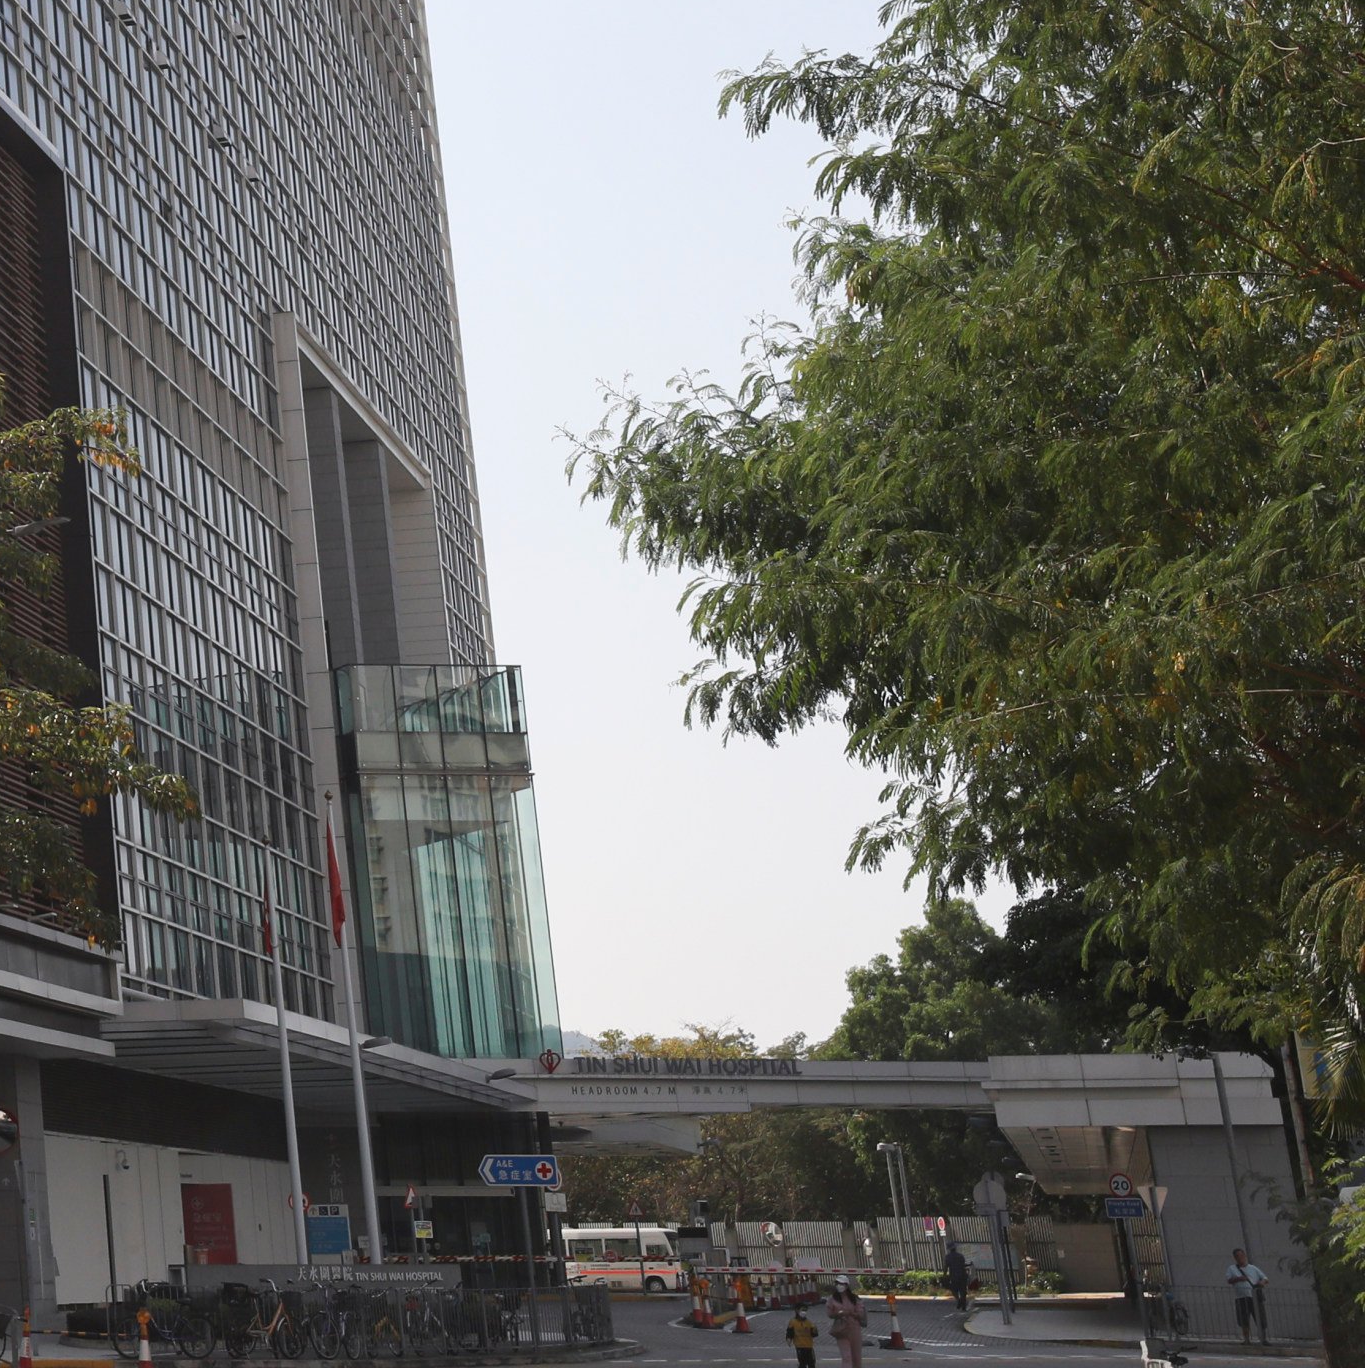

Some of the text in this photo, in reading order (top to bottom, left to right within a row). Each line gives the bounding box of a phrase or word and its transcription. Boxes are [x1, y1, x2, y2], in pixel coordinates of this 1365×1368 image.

[573, 1056, 804, 1076] TIN SHUI WAI HOSPITAL
[571, 1085, 638, 1096] HEADROOM
[668, 1085, 677, 1096] M
[496, 1159, 514, 1168] A&E
[498, 1170, 533, 1181] 急症室
[1113, 1180, 1129, 1191] 20
[297, 1265, 354, 1281] 天水圍醫院
[355, 1271, 444, 1281] TIN SHUI WAI HOSPITAL
